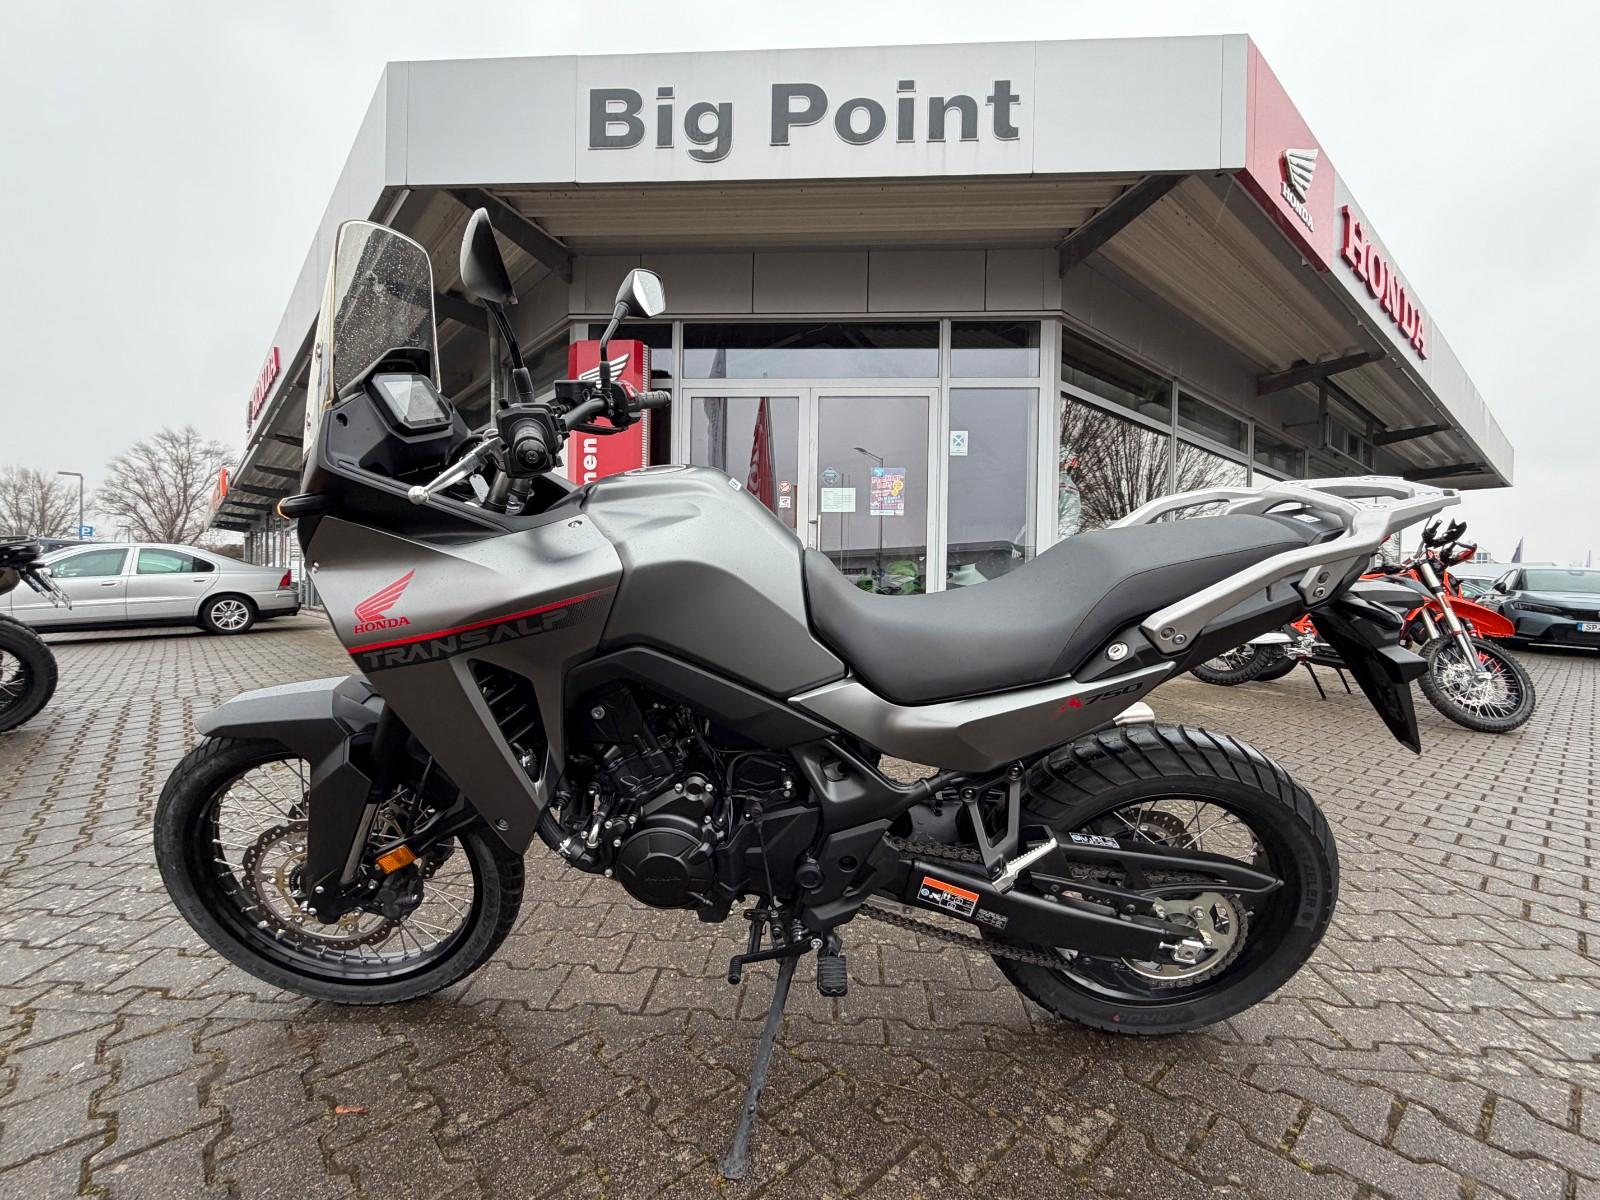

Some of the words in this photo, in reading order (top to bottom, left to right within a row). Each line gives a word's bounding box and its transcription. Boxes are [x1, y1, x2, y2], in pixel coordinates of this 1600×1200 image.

[588, 86, 733, 163] Big
[769, 79, 1021, 147] Point
[1280, 181, 1314, 232] HONDA
[1340, 205, 1427, 359] HONDA
[354, 616, 411, 634] HONDA
[363, 609, 569, 669] TRANSALP
